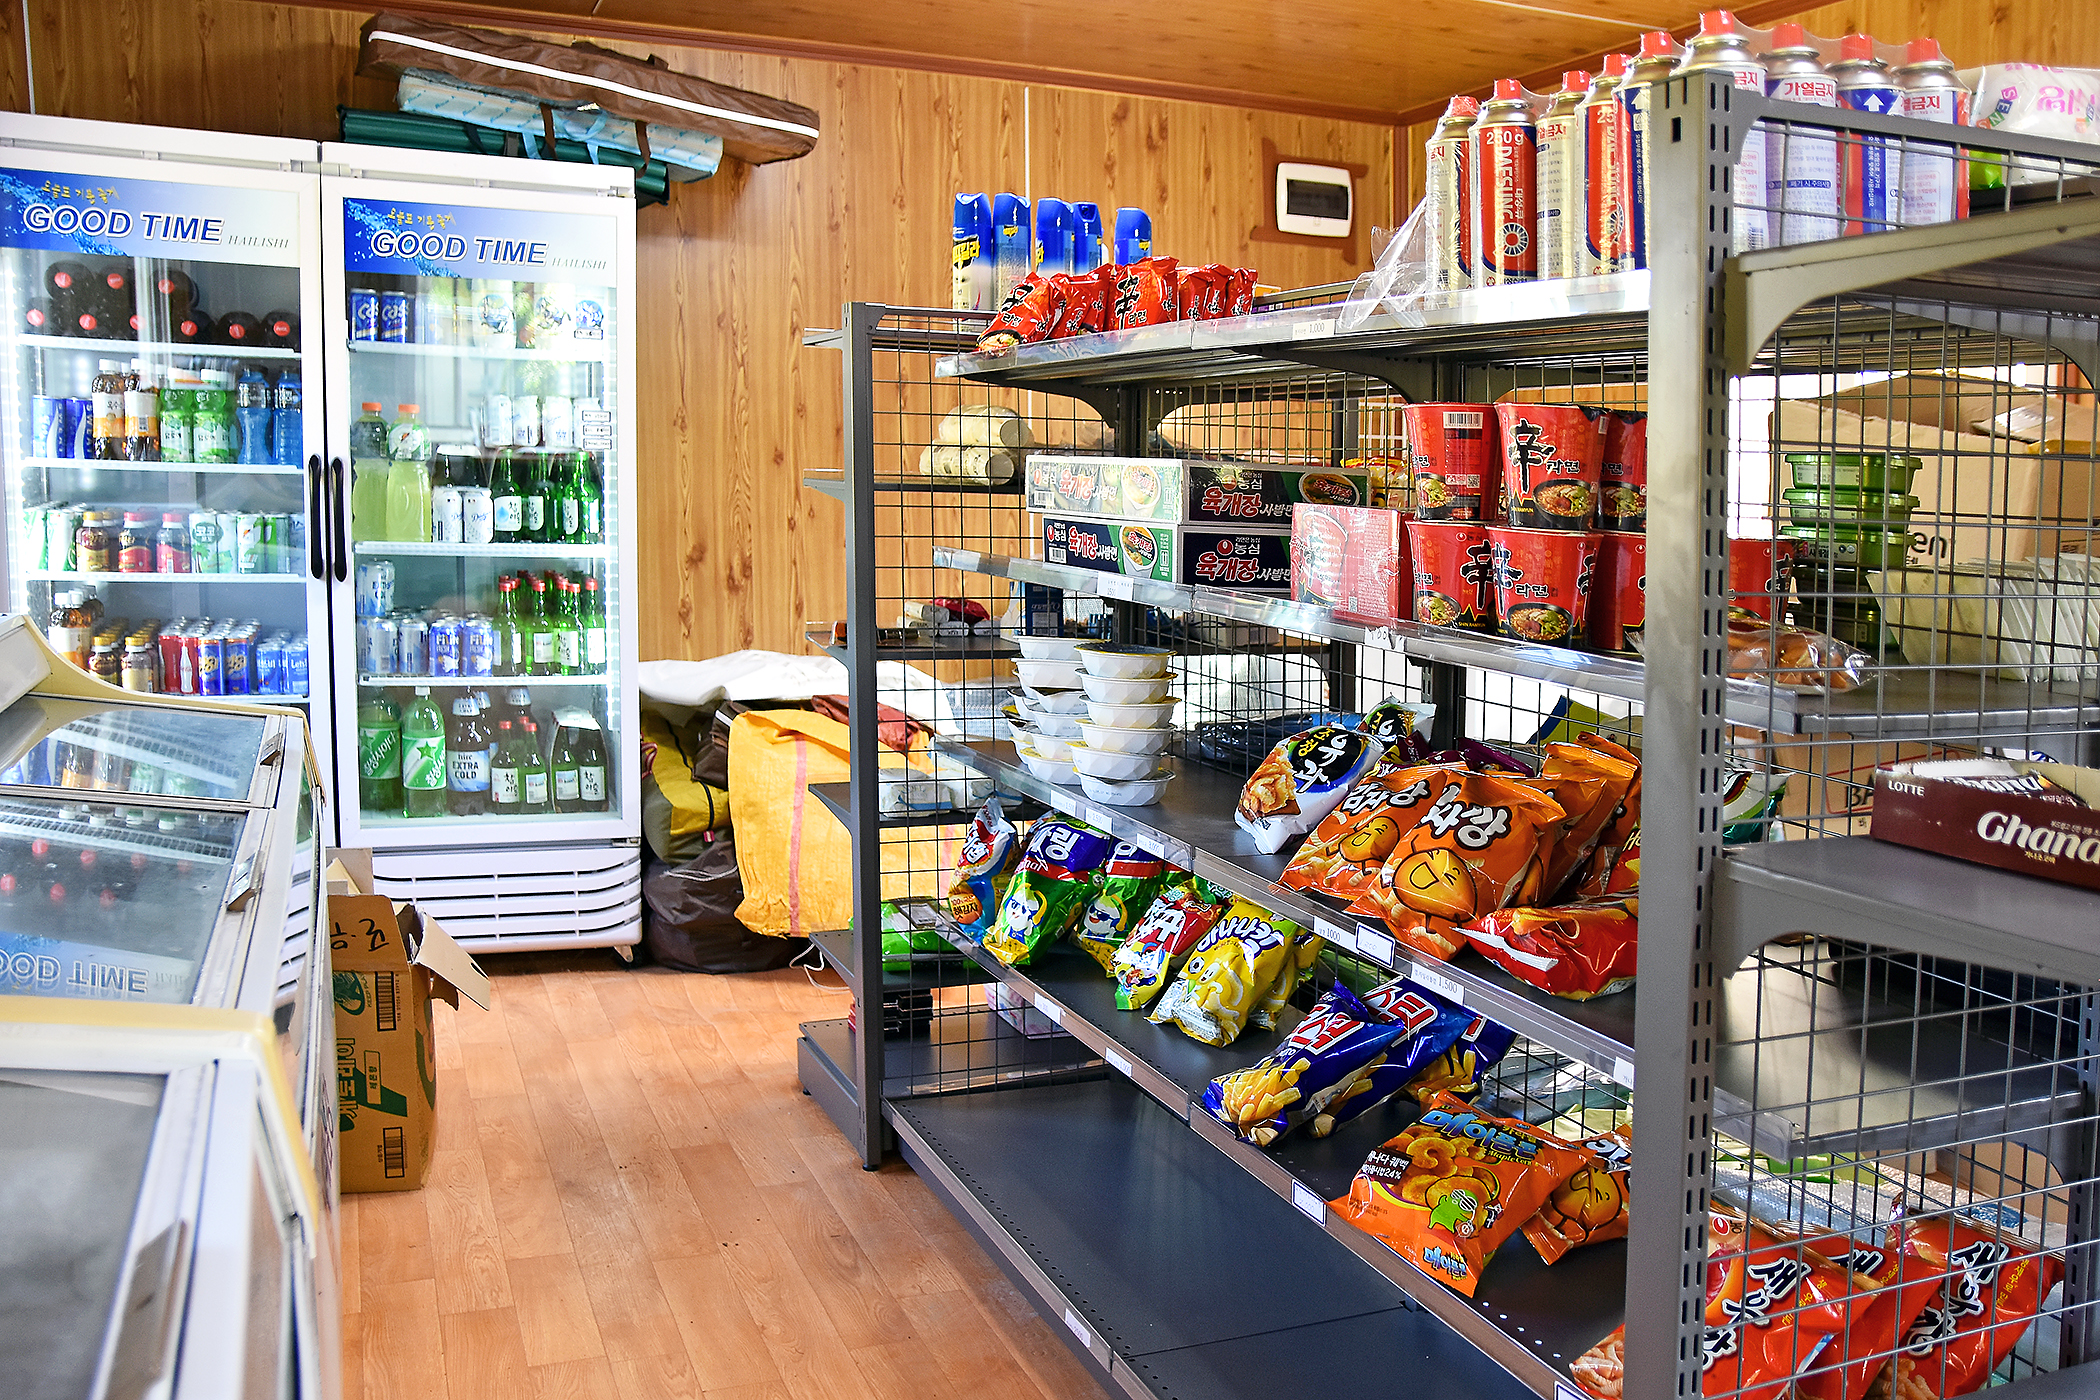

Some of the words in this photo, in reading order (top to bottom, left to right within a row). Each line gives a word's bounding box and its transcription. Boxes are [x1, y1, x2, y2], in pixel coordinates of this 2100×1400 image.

[1785, 82, 1834, 98] 가열금지
[24, 204, 133, 238] GOOD
[141, 211, 224, 244] TIME
[371, 230, 467, 262] GOOD
[474, 236, 548, 266] TIME
[1127, 309, 1148, 327] 라면
[1508, 417, 1556, 495] 辛
[1545, 458, 1580, 475] 라면
[1202, 486, 1262, 518] 육개장
[1068, 525, 1098, 559] 육개장
[1234, 544, 1261, 556] 농심
[1195, 551, 1260, 583] 육개장
[1515, 582, 1549, 599] 라면
[363, 730, 397, 777] 칠성사이다
[452, 761, 480, 770] EXTRA
[454, 771, 477, 780] COLD
[1887, 779, 1926, 797] LOTTE
[953, 901, 979, 919] 햇감자
[1196, 915, 1279, 962] 바나나킥
[1416, 1108, 1538, 1160] 메이플콘
